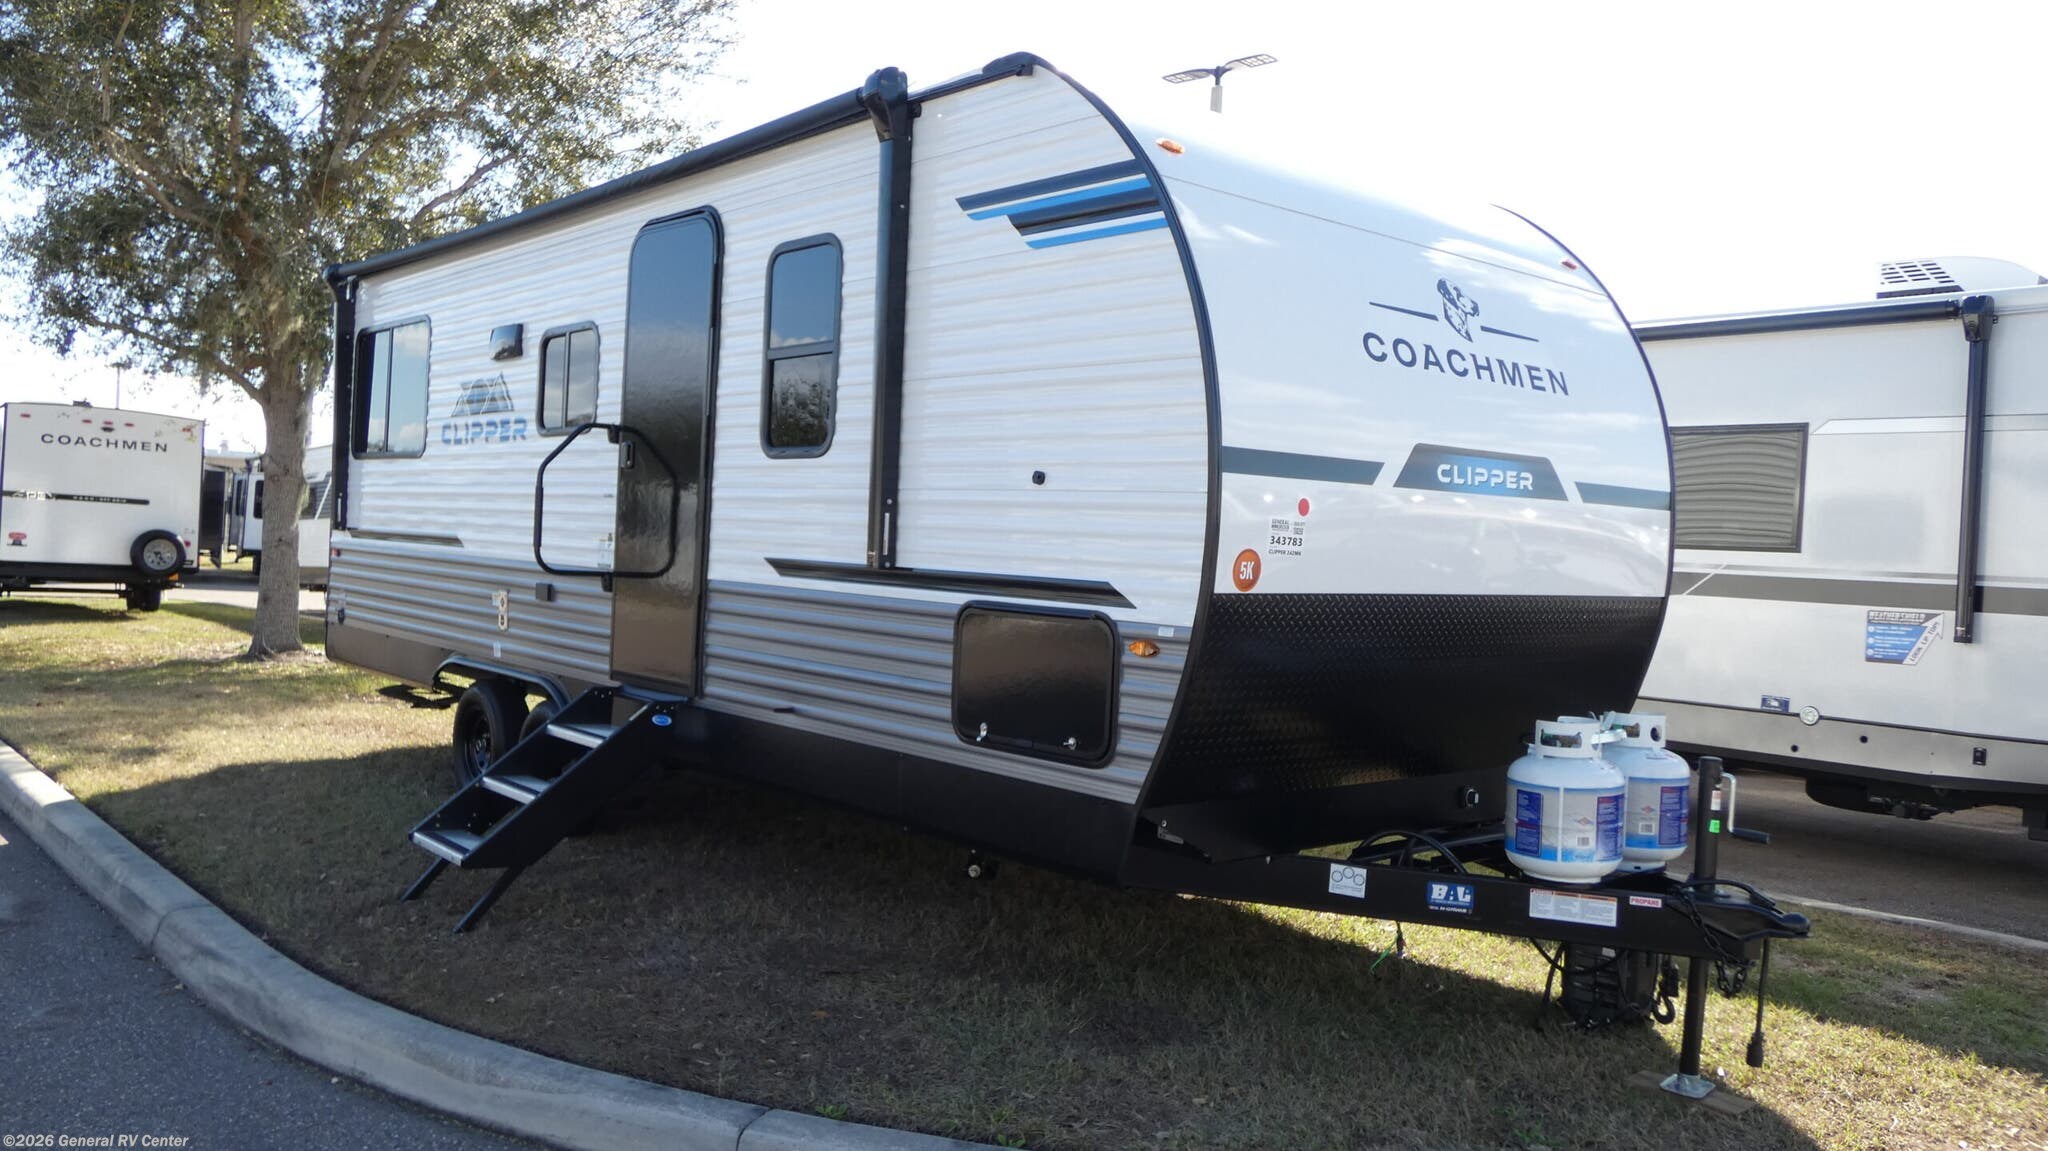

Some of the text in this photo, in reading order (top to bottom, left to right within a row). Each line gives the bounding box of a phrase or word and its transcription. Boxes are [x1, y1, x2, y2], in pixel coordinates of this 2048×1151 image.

[1362, 332, 1569, 396] COACHMEN
[41, 433, 168, 452] COACHMEN
[442, 418, 527, 445] CLIPPER
[1437, 463, 1533, 491] CLIPPER
[1269, 536, 1303, 547] 343783
[1240, 561, 1254, 580] 5K
